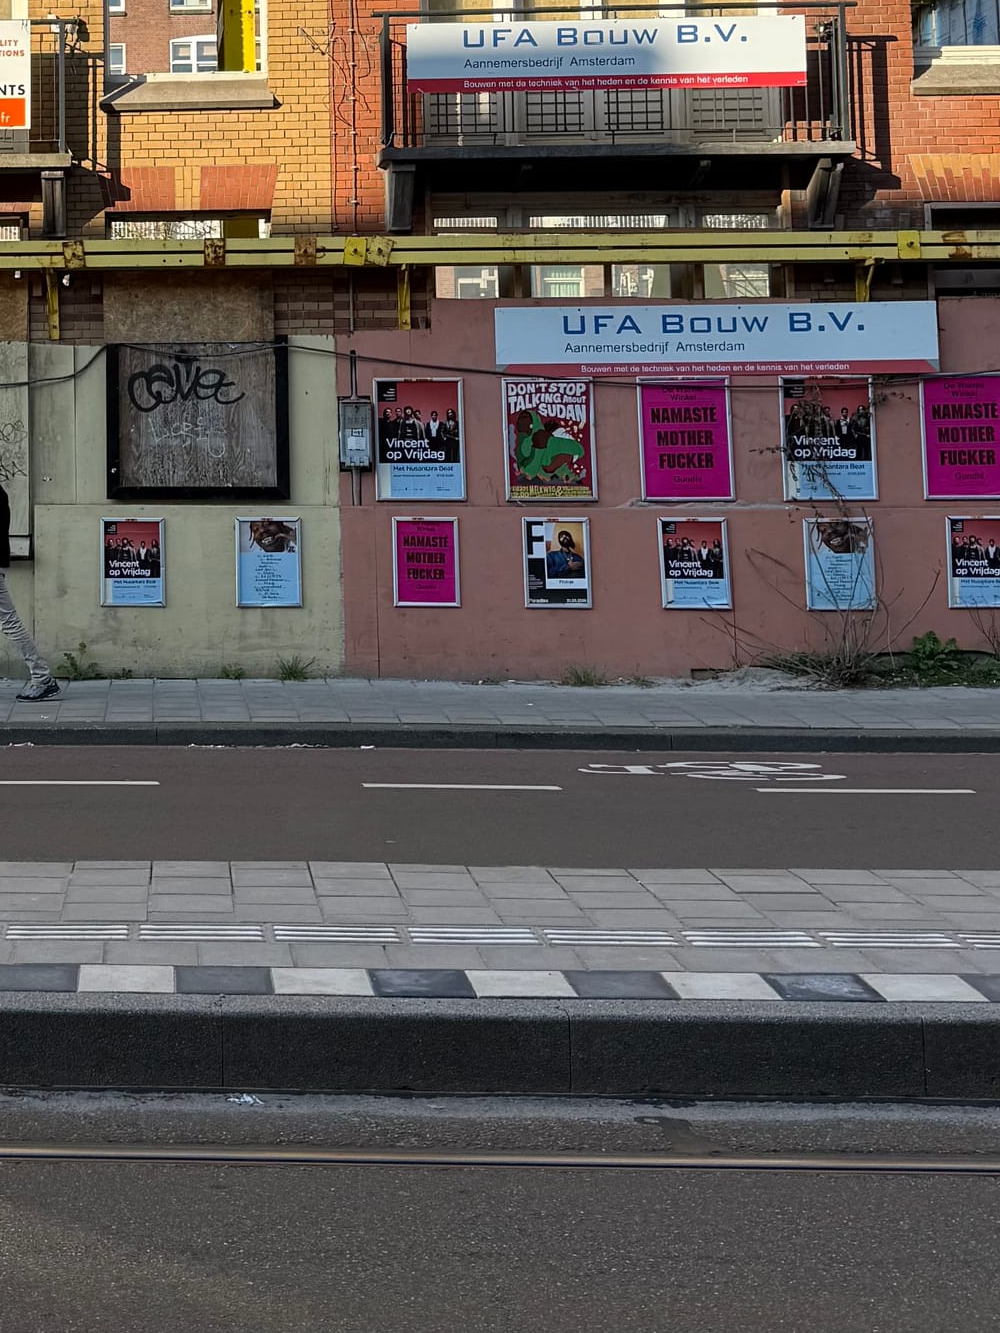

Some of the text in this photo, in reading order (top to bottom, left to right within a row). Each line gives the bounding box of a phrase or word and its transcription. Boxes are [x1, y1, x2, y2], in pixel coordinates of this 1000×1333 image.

[463, 29, 538, 48] UFA
[677, 23, 748, 43] B.V.
[464, 56, 635, 69] Aannemersbedrijf Amsterdam
[464, 80, 496, 88] Bouwen
[528, 79, 562, 87] techniek
[582, 78, 595, 86] het
[597, 78, 622, 86] heden
[697, 76, 710, 84] het
[712, 75, 748, 84] verleden
[563, 315, 642, 334] UFA
[789, 311, 865, 332] B.V.
[564, 341, 745, 354] Aannemersbedrijf Amsterdam
[581, 365, 611, 373] Bouwen
[706, 364, 730, 372] heden
[815, 363, 850, 371] verleden
[507, 383, 586, 396] DON'T STOP
[508, 393, 562, 415] TALKING
[931, 400, 999, 420] NAMASTÉ
[538, 403, 586, 423] SUDAN
[651, 404, 717, 423] NAMASTÉ
[657, 430, 713, 446] MOTHER
[793, 435, 840, 446] Vincent
[938, 426, 995, 443] MOTHER
[386, 438, 430, 448] Vincent
[386, 449, 446, 461] op Vrijdag
[793, 447, 857, 459] op Vrijdag
[940, 449, 996, 466] FUCKER
[659, 452, 714, 469] FUCKER
[108, 560, 140, 568] Vincent
[406, 552, 446, 564] MOTHER
[668, 560, 702, 568] Vincent
[955, 558, 988, 567] Vincent
[122, 568, 151, 577] Vrijdag
[407, 568, 445, 580] FUCKER
[682, 568, 713, 578] Vrijdag
[955, 568, 968, 576] op
